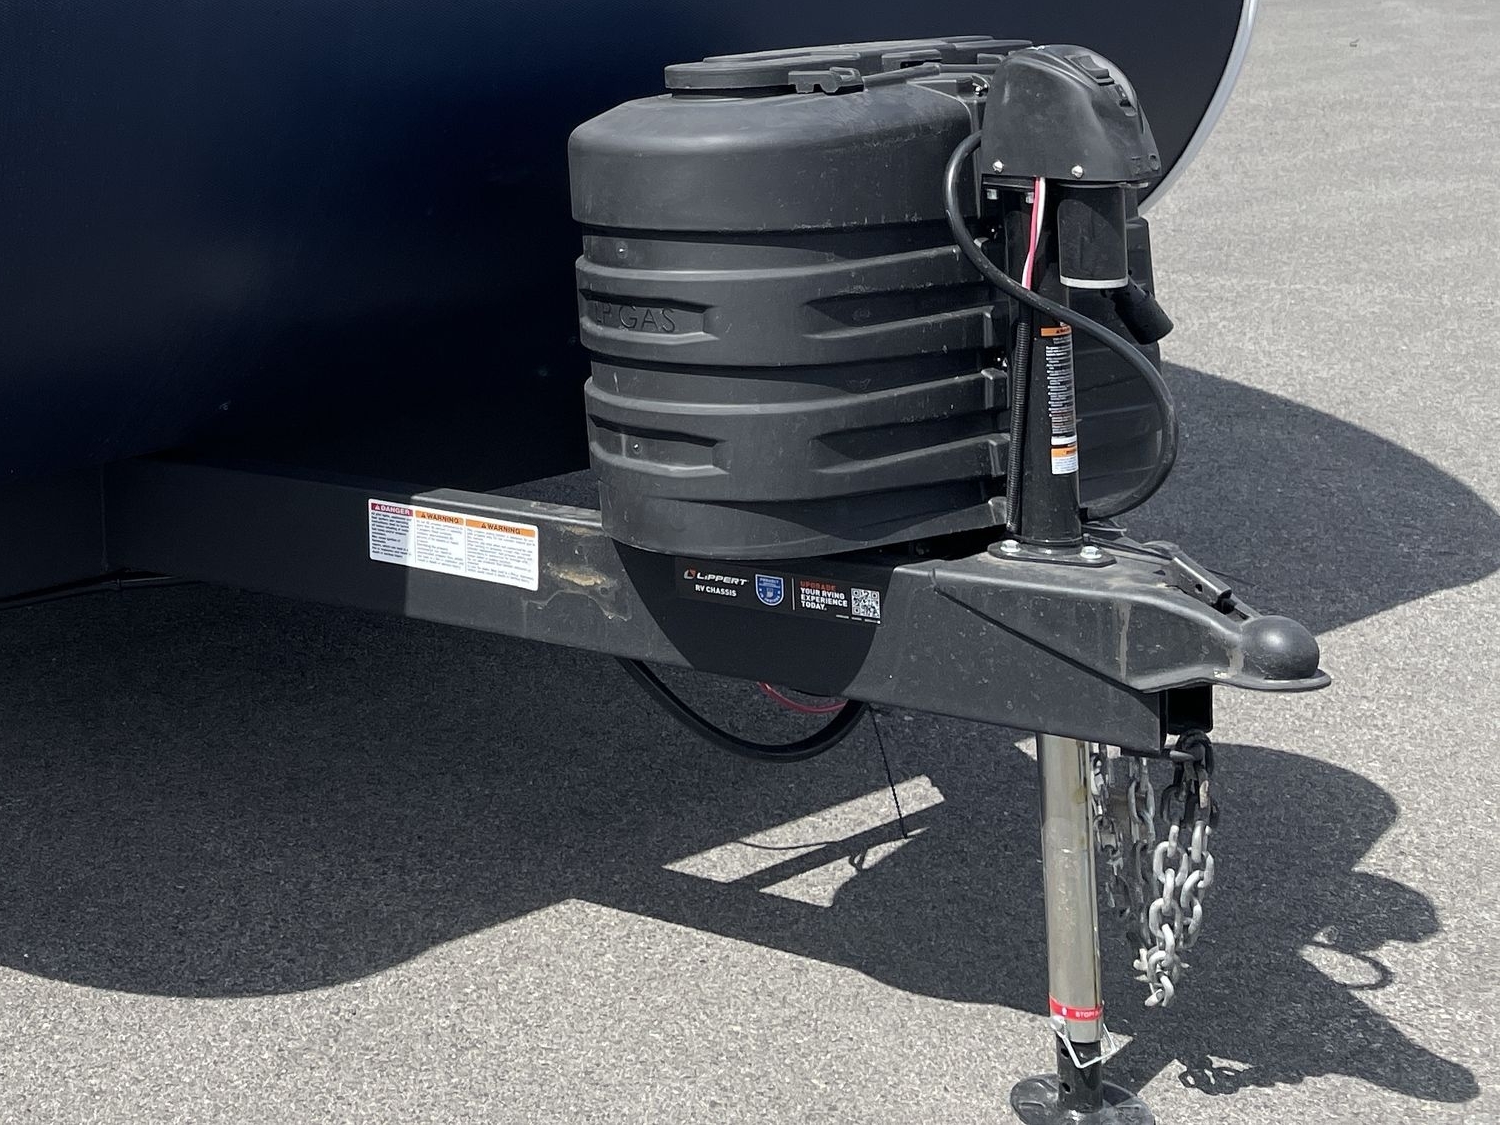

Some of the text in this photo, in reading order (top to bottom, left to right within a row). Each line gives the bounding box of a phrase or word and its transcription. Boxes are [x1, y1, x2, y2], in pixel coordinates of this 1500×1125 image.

[618, 305, 676, 333] GAS
[381, 504, 411, 516] DANGER
[426, 512, 459, 524] WARNING
[487, 523, 521, 535] WARNING
[695, 584, 737, 597] RV CHASSIS
[800, 580, 837, 591] UPGRADE
[800, 587, 845, 600] YOUR RVING
[800, 594, 848, 607] EXPERIENCE
[801, 600, 827, 611] TODAY.
